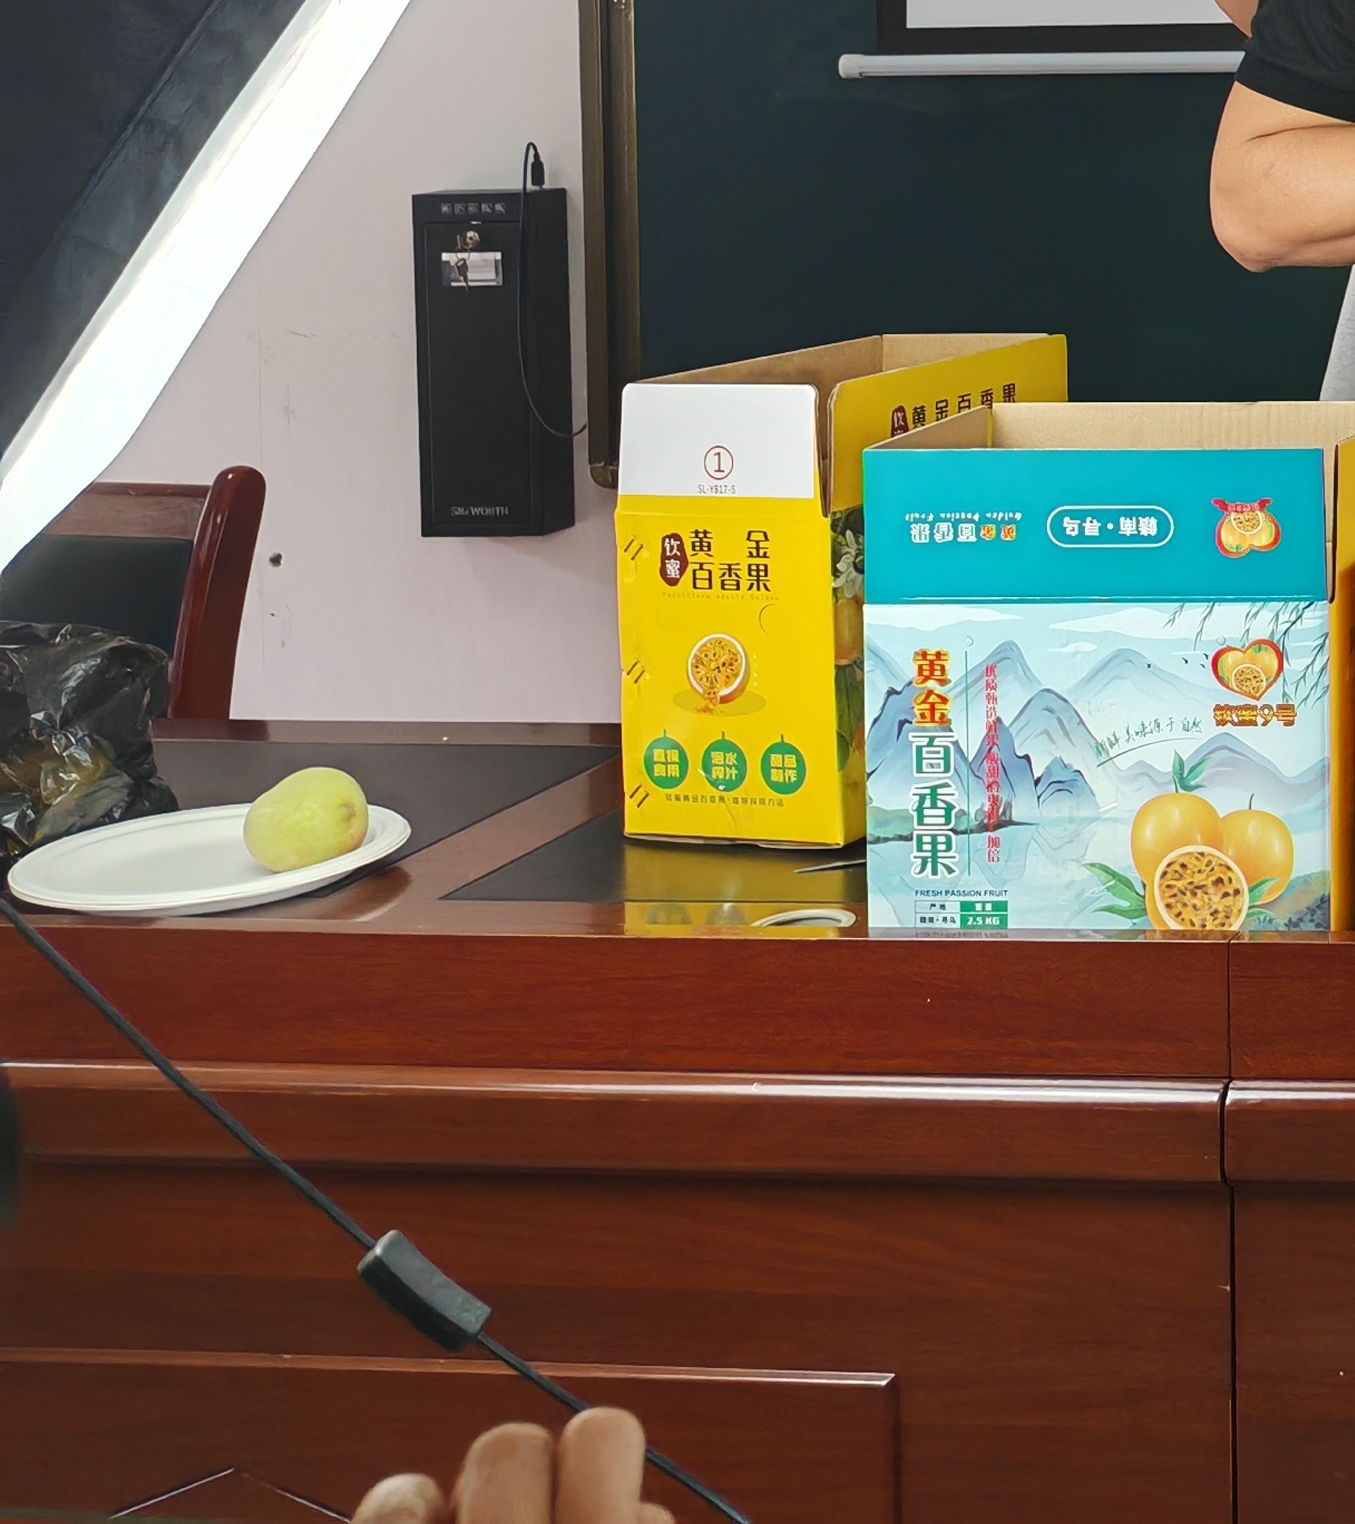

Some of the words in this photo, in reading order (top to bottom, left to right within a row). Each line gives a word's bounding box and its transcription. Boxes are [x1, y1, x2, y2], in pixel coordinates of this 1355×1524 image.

[689, 562, 772, 592] 百香果
[1212, 702, 1298, 727] 钦蜜9号
[908, 647, 960, 880] 黄金百香果
[914, 889, 943, 898] FRESH
[944, 889, 982, 898] PASSION
[983, 889, 1009, 898] FRUIT
[966, 916, 983, 926] 2.5
[985, 916, 1001, 926] KG
